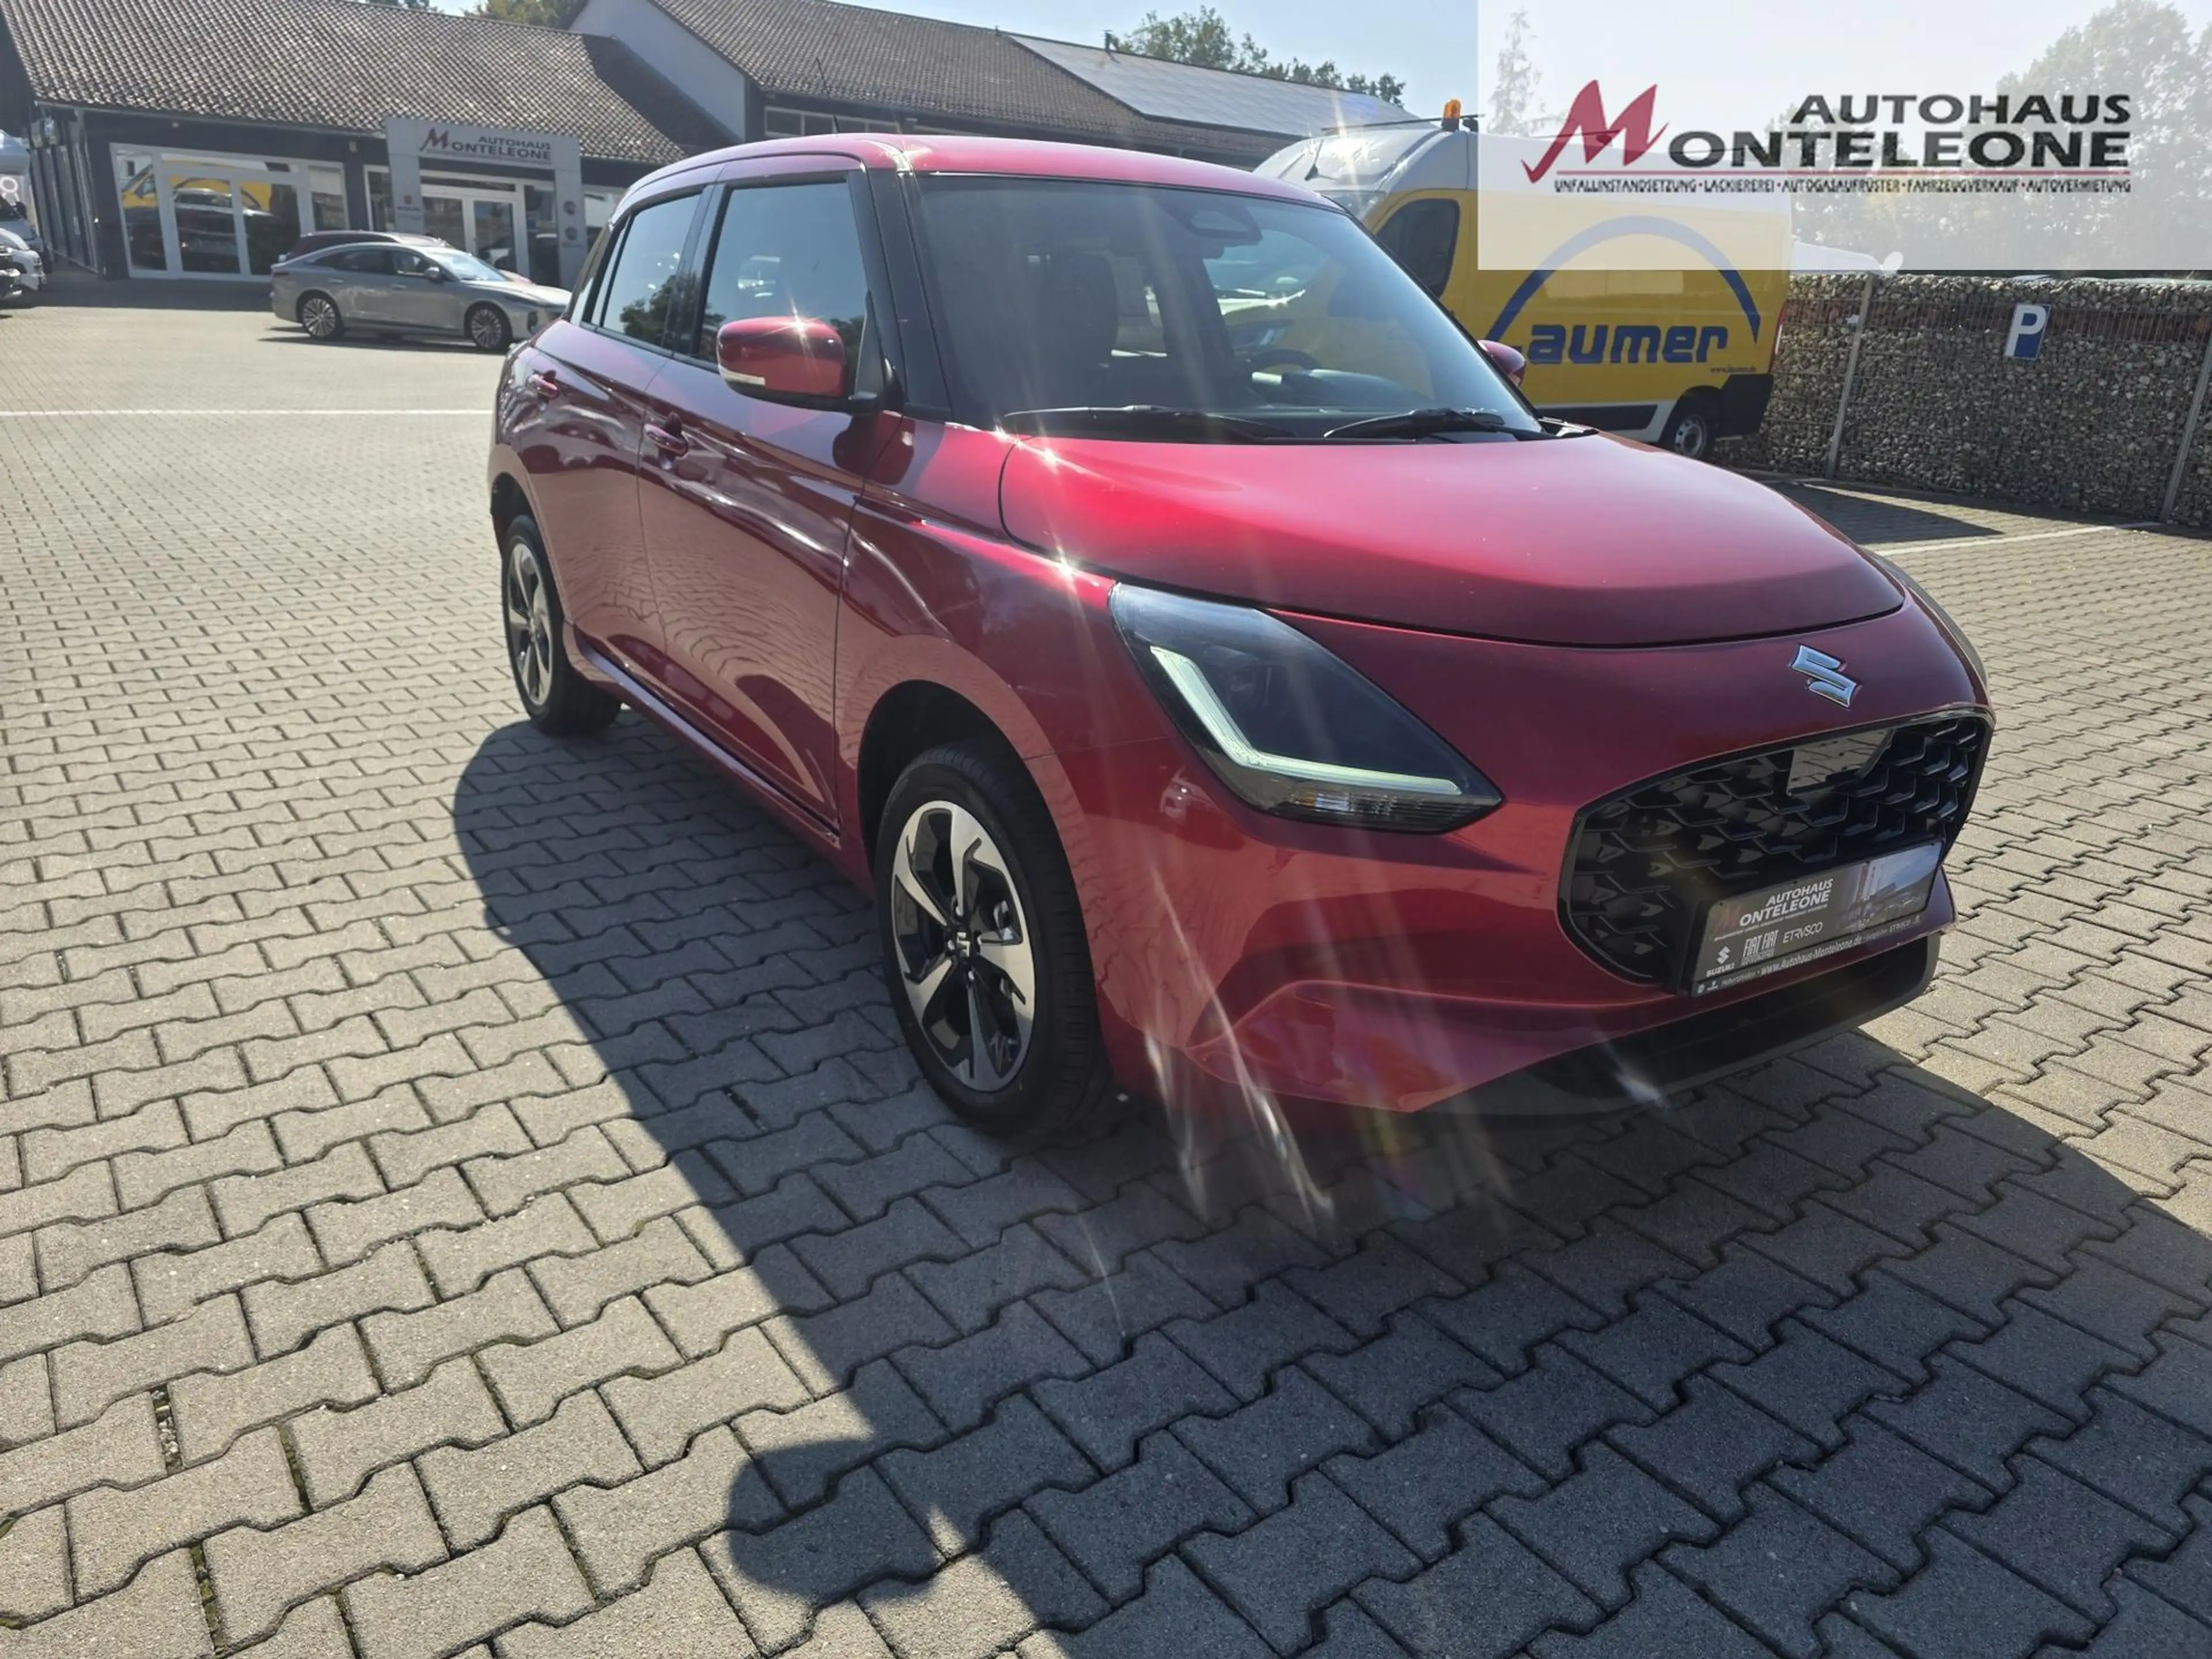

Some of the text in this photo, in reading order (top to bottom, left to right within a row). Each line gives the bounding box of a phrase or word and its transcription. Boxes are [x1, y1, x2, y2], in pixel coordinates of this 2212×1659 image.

[419, 127, 552, 161] MONTELEONE
[478, 136, 551, 150] AUTOHAUS
[1528, 324, 1728, 364] aumer
[2004, 303, 2047, 357] P
[1766, 878, 1834, 907] AUTOHAUS
[1706, 962, 1736, 978] SUZUKI
